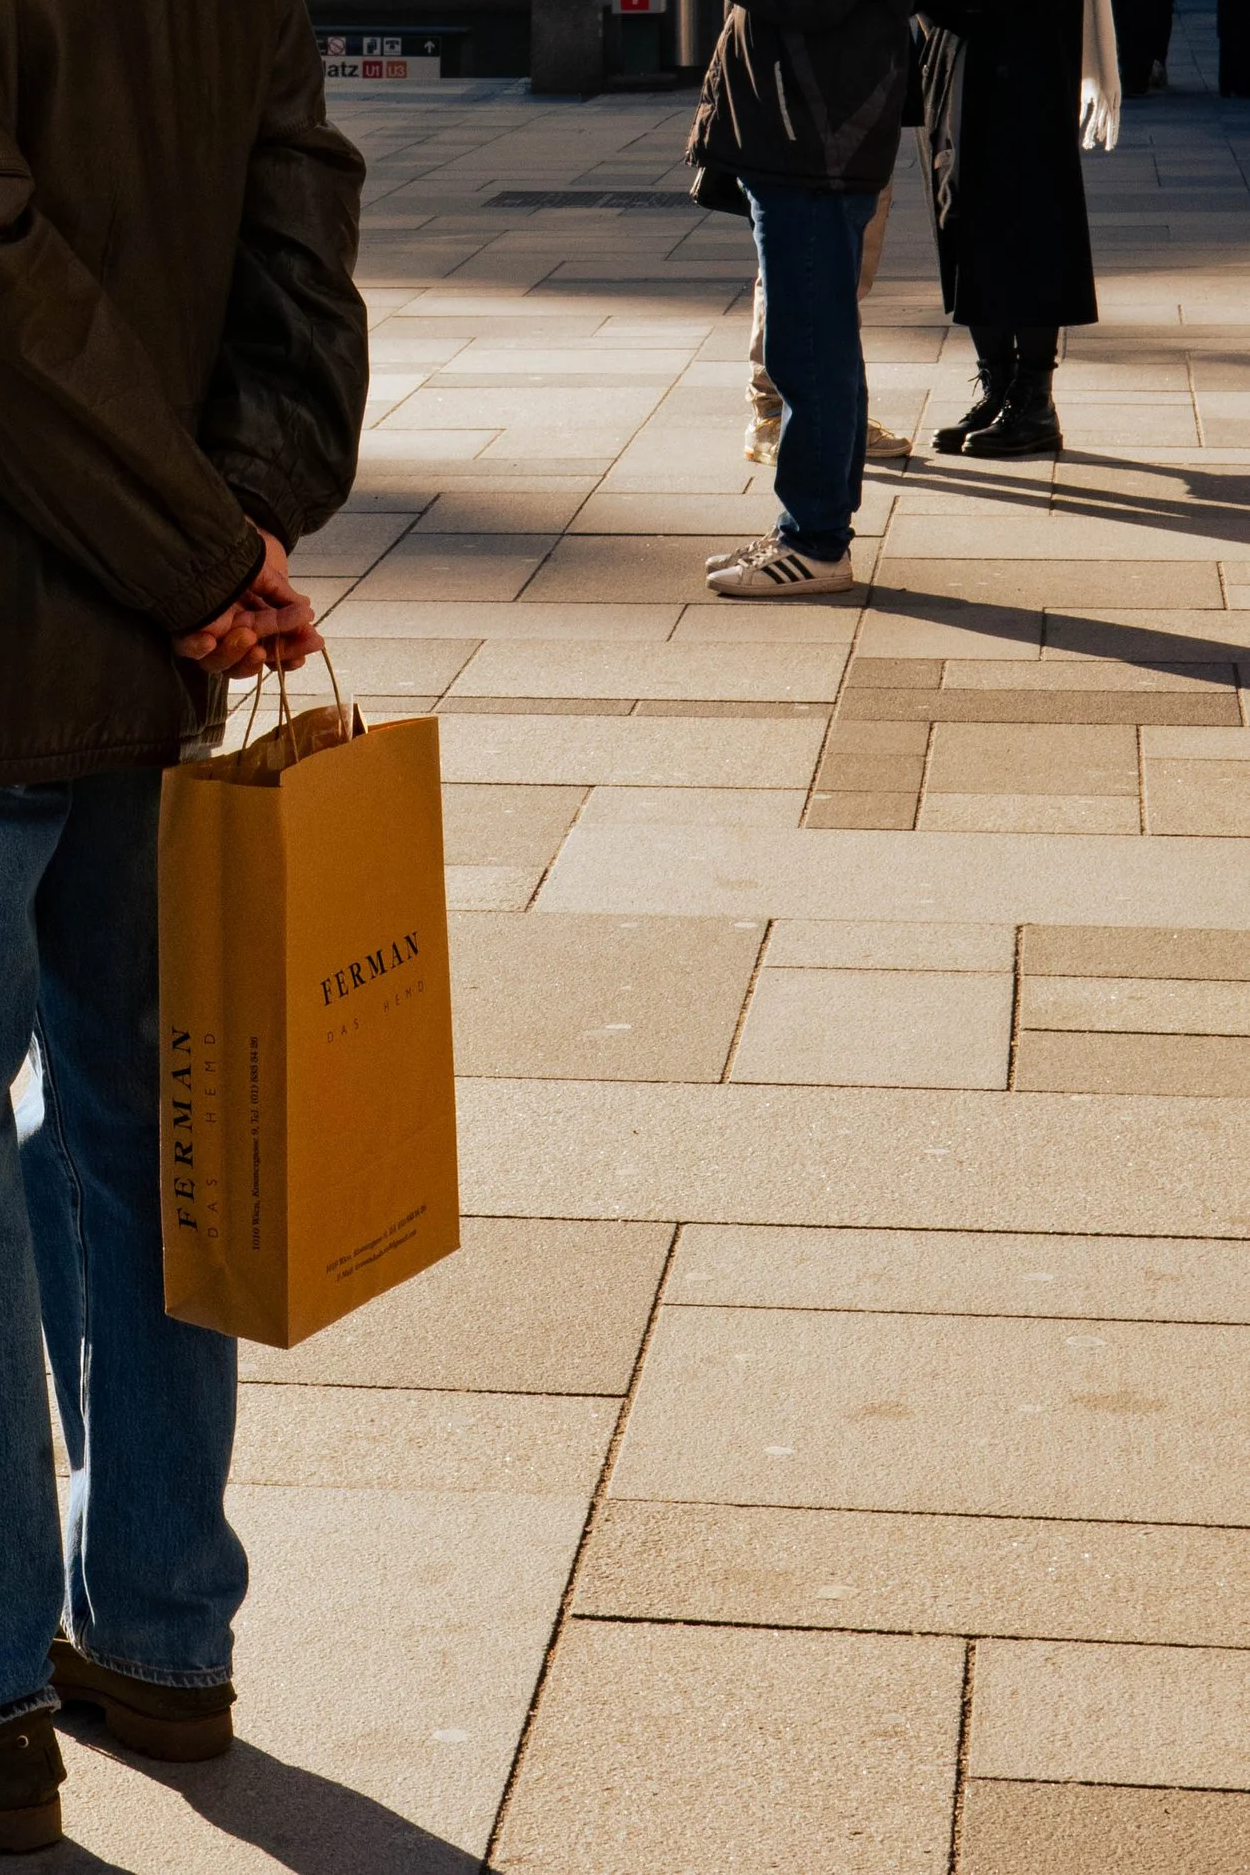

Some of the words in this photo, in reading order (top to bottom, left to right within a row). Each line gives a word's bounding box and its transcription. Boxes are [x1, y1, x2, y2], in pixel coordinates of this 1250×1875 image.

[366, 64, 380, 77] U1
[388, 64, 404, 76] U3
[320, 931, 419, 1006] FERMAN
[327, 1018, 359, 1043] DAS
[383, 980, 424, 1013] HEMD
[204, 1033, 216, 1123] HEMD
[250, 1084, 259, 1105] (01)
[171, 1026, 198, 1232] FERMAN
[250, 1107, 259, 1124] Tel.
[206, 1178, 218, 1238] DAS
[252, 1227, 260, 1251] 1010
